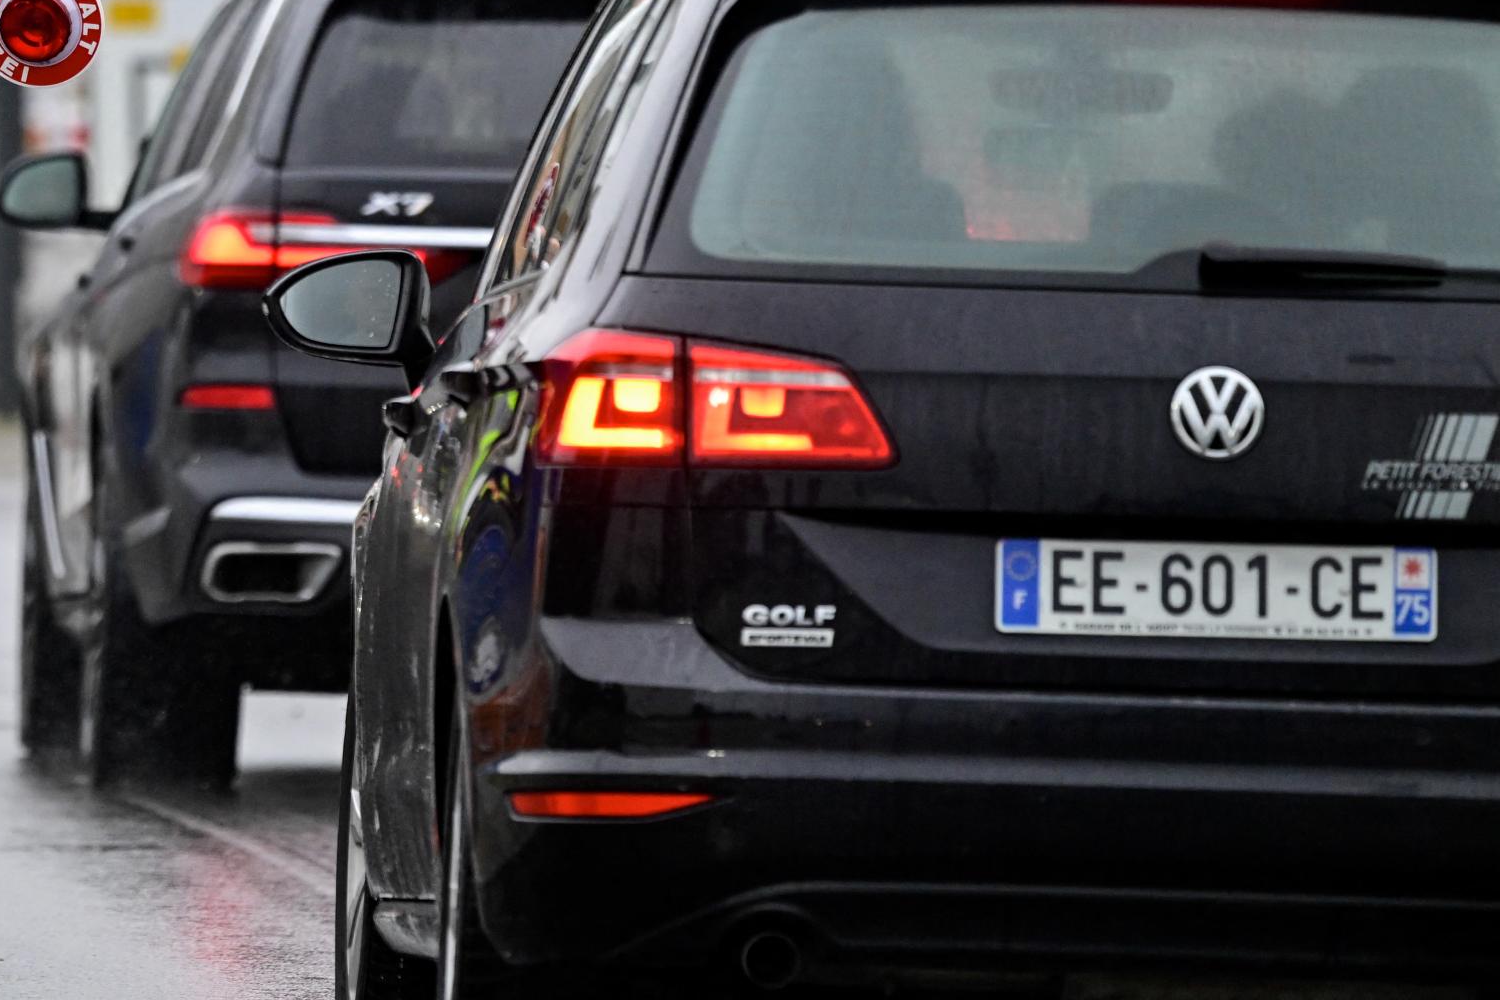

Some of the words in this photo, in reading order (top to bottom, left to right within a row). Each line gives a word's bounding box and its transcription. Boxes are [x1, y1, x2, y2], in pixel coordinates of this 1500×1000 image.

[360, 191, 434, 216] X7
[1012, 588, 1028, 611] F
[1052, 549, 1385, 620] EE-601-CE
[1396, 592, 1431, 627] 75
[742, 603, 837, 627] GOLF
